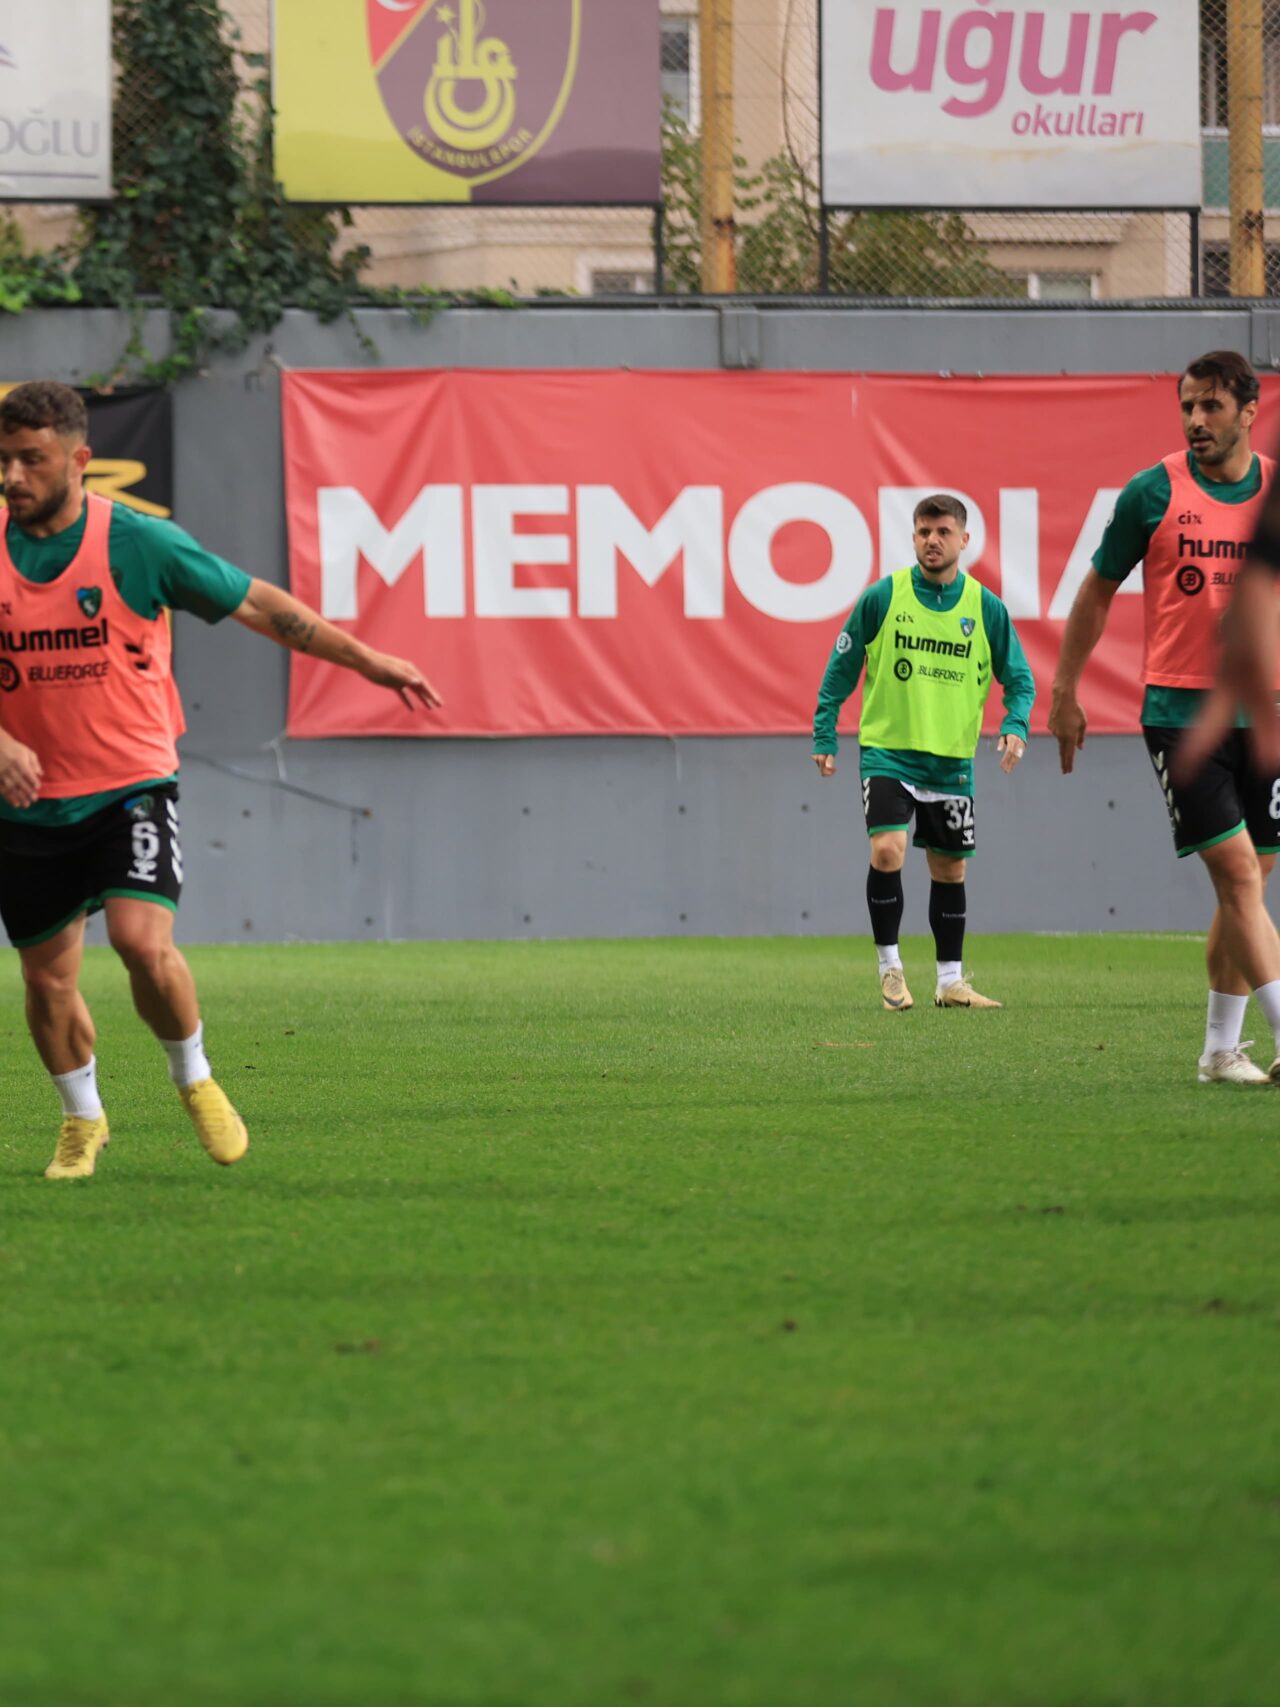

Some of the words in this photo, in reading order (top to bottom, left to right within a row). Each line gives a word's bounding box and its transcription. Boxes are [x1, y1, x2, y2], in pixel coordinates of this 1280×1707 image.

[1011, 102, 1144, 138] okulları
[1178, 533, 1248, 560] humm
[894, 630, 972, 659] hummel
[943, 799, 974, 830] 32
